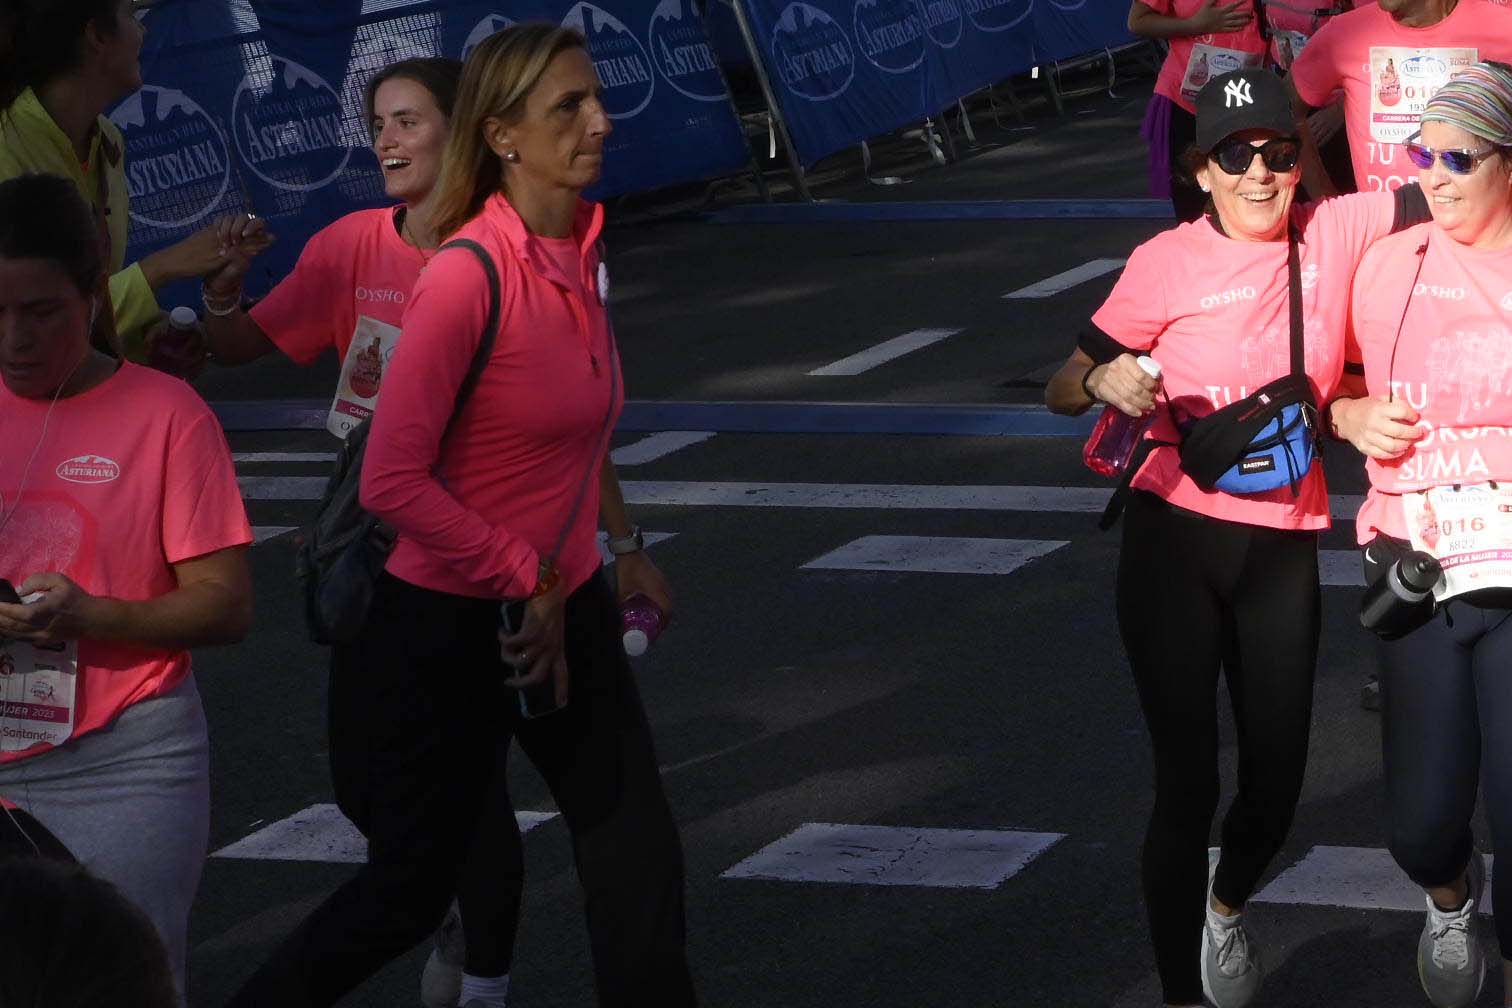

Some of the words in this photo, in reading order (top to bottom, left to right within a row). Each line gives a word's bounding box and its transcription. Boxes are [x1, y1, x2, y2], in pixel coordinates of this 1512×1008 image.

[1367, 142, 1395, 165] TU
[355, 286, 405, 304] OYSHO
[1200, 286, 1257, 309] OYSHO
[60, 464, 115, 478] ASTURIANA
[1399, 447, 1489, 481] SUMA
[1442, 516, 1485, 537] 016
[3, 727, 58, 741] Santander
